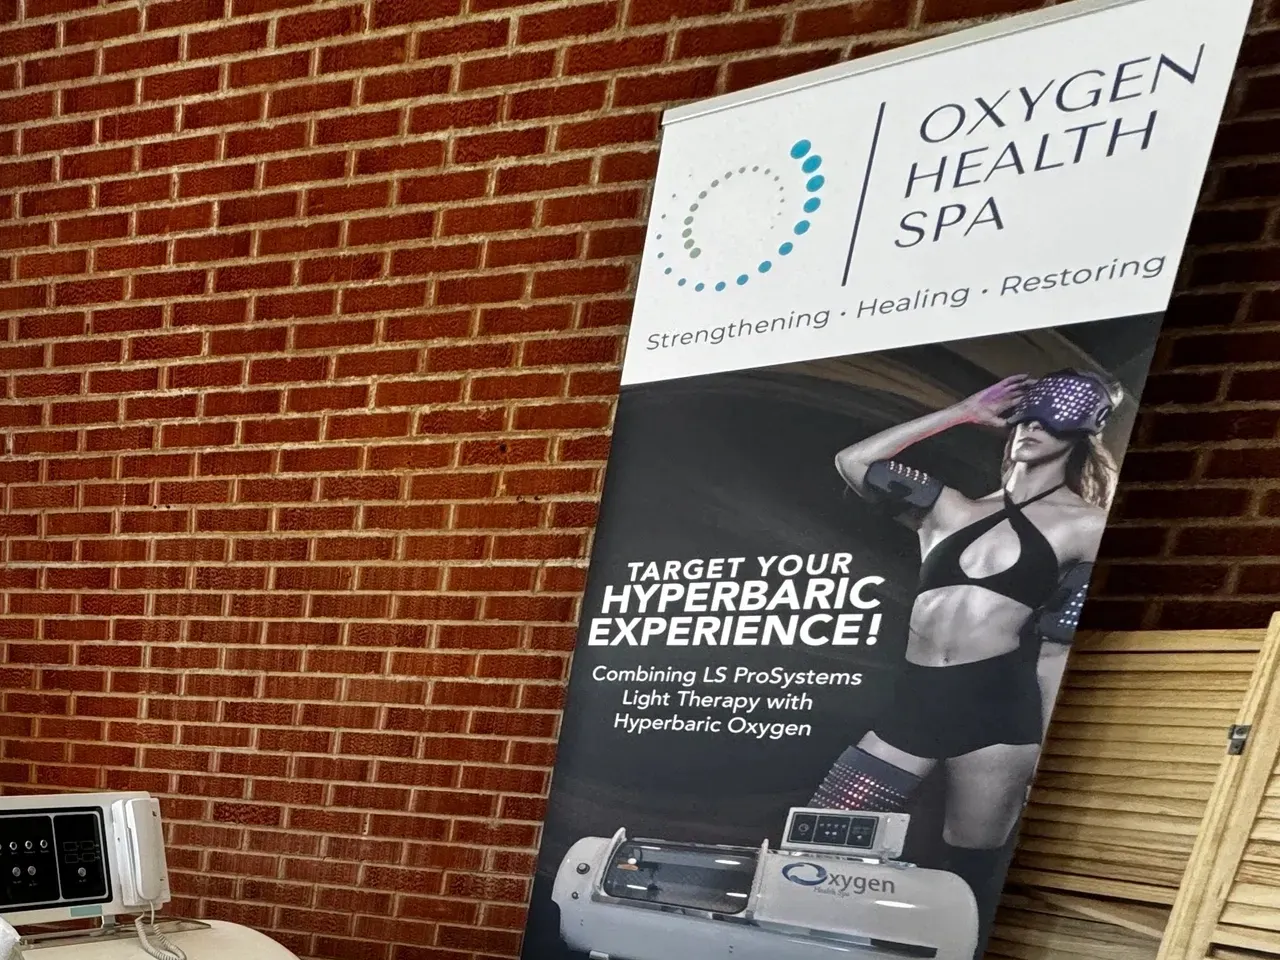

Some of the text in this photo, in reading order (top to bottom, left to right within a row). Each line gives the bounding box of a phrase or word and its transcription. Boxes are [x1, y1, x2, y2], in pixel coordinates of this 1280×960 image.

[920, 44, 1207, 144] OXYGEN
[904, 110, 1159, 199] HEALTH
[894, 196, 1006, 249] SPA
[646, 254, 1166, 351] Strengthening Healing Restoring
[627, 552, 853, 582] TARGET YOUR
[601, 575, 886, 614] HYPERBARIC
[587, 613, 883, 647] EXPERIENCE!
[592, 665, 863, 689] Combining LS ProSystems
[622, 690, 813, 713] Light Therapy with
[614, 713, 812, 739] Hyperbaric Oxygen
[782, 861, 895, 894] Oxygen
